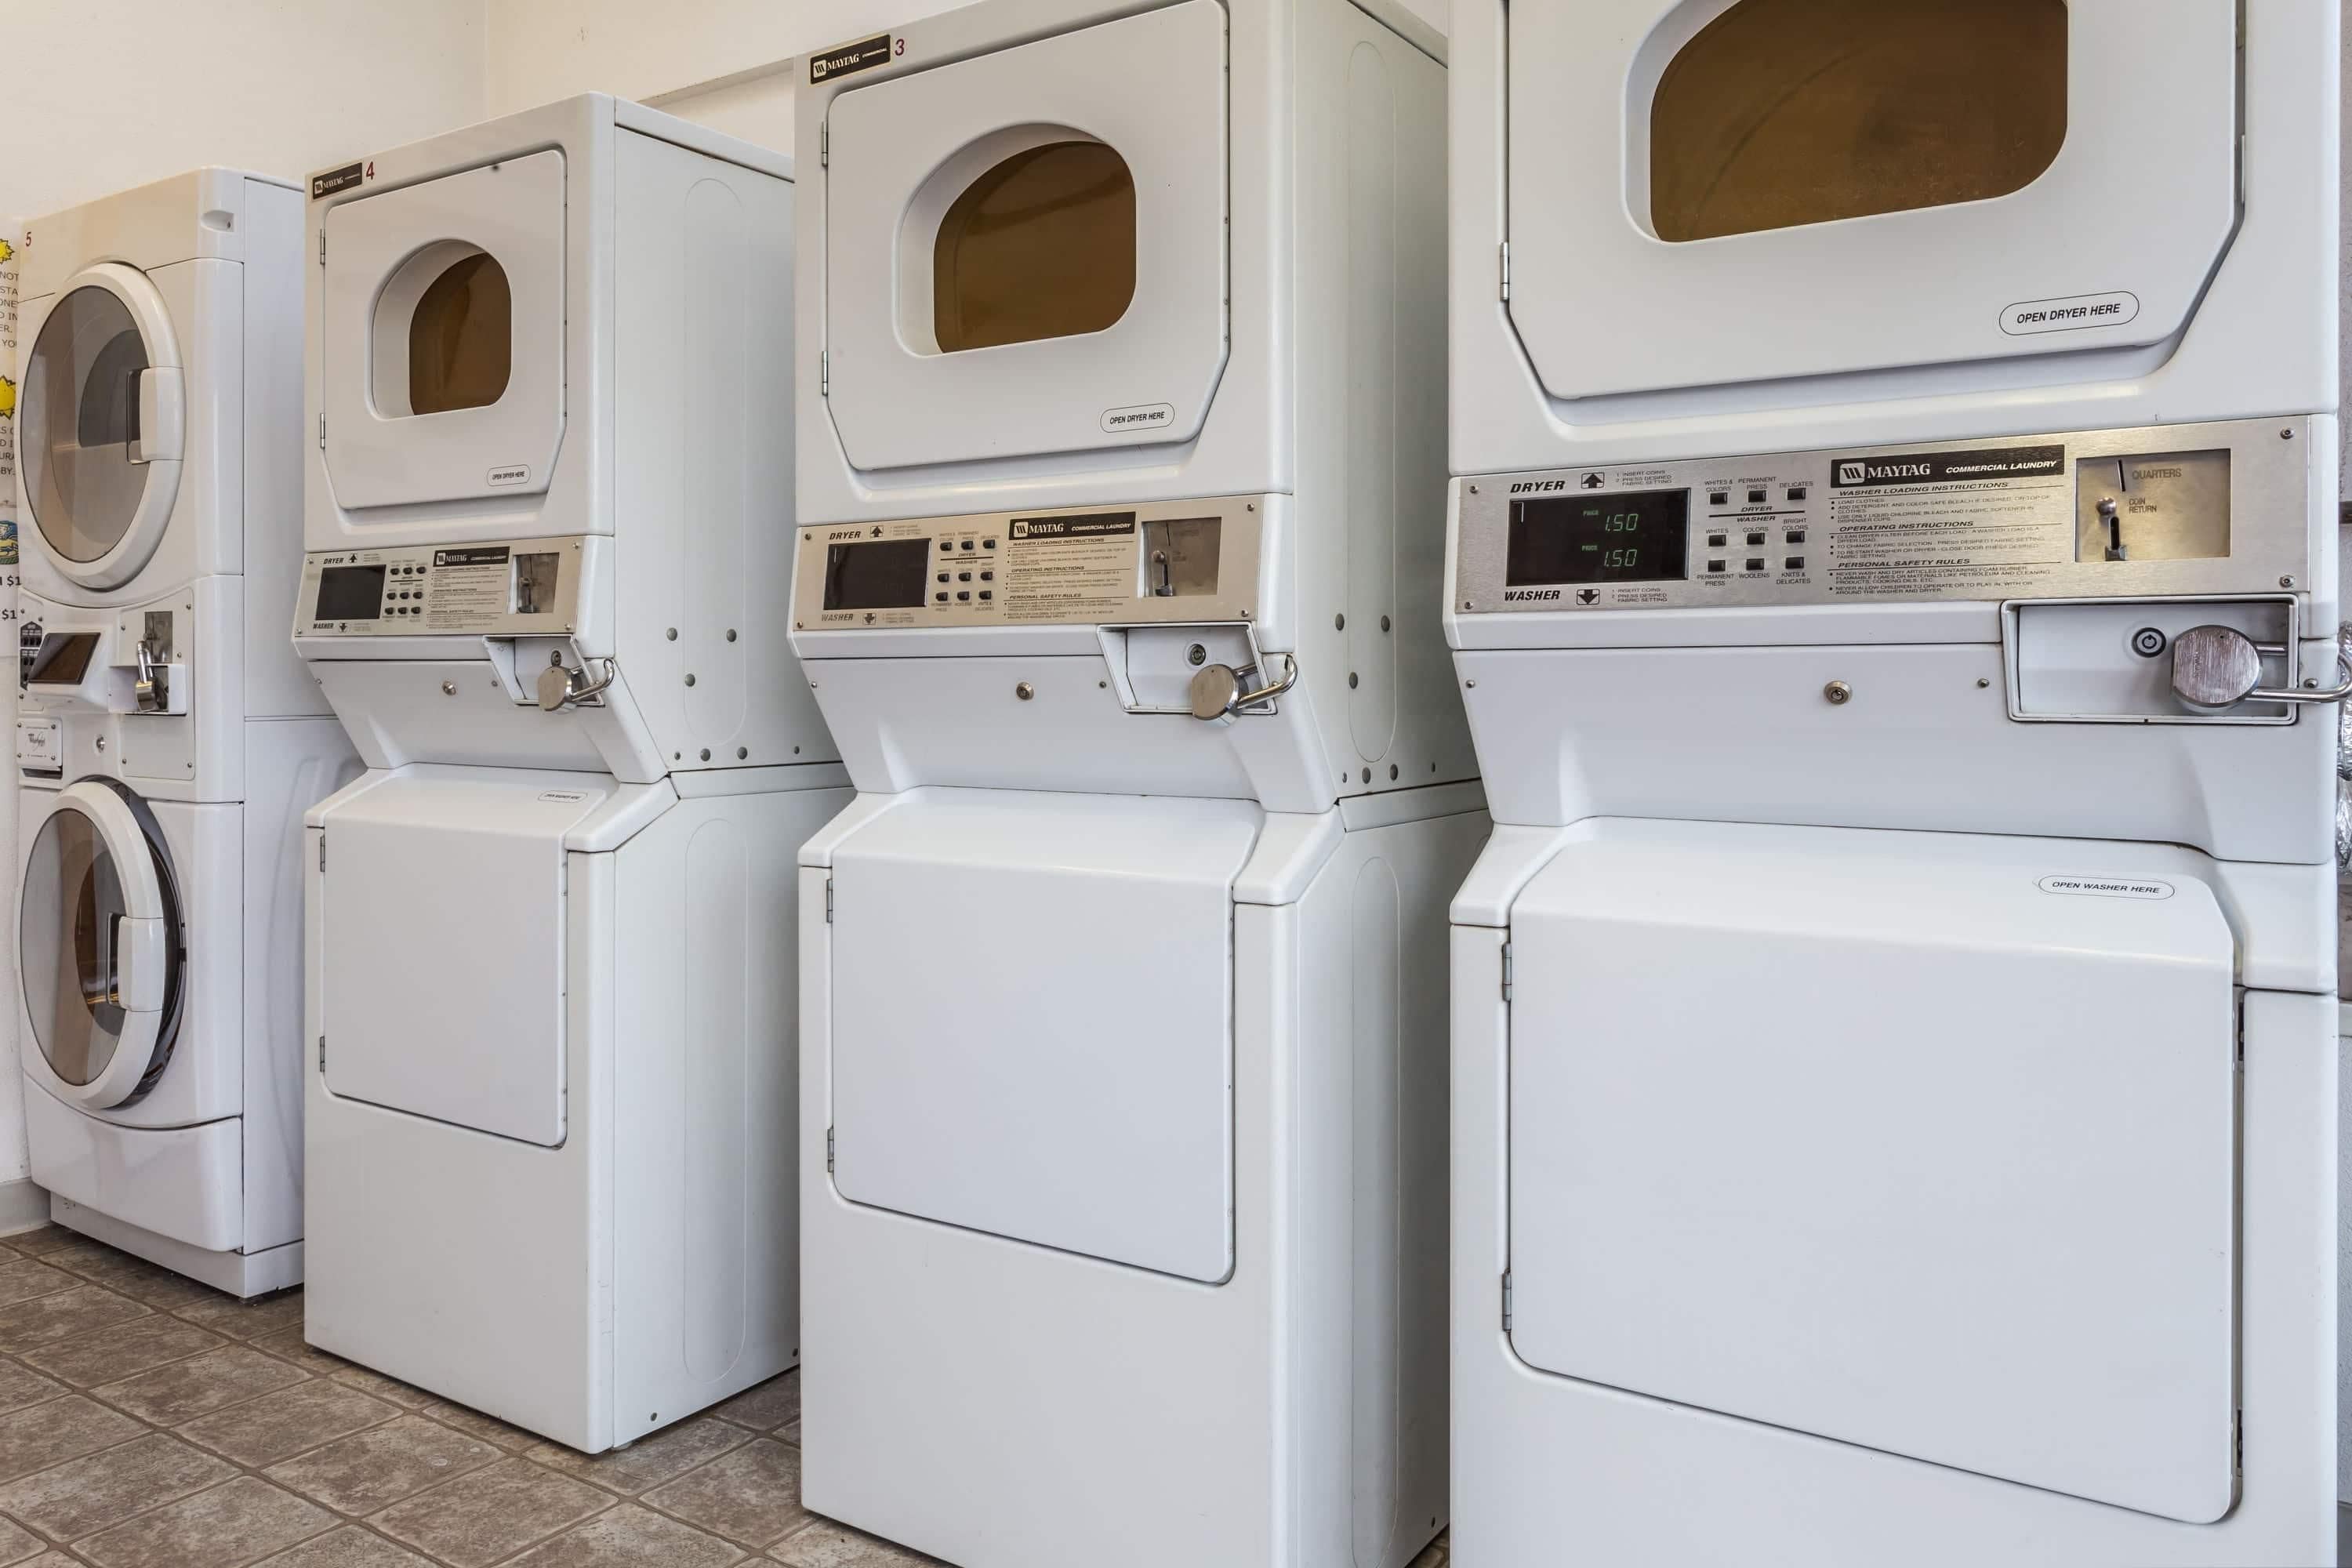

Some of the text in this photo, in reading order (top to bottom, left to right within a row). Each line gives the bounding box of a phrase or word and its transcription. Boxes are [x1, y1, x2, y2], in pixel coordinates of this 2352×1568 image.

[895, 38, 906, 56] 3
[827, 53, 860, 71] MAYTAG
[365, 162, 375, 180] 4
[26, 231, 32, 247] 5
[2016, 303, 2121, 324] OPEN DRYER HERE
[2, 339, 17, 348] YO
[1109, 411, 1166, 425] OPEN DRYER HERE
[1867, 460, 2057, 478] MAYTAG COMMERCIAL LAUNDRY
[2132, 468, 2183, 480] QUARTERS
[1510, 480, 1566, 493] DRYER
[1932, 482, 2009, 492] INSTRUCTIONS
[2129, 497, 2146, 506] COIN
[2129, 505, 2158, 514] RETURN
[1029, 523, 1064, 534] MAYTAG
[1605, 514, 1639, 532] 1.50
[1839, 521, 1974, 532] OPERATING INSTRUCTIONS
[829, 531, 862, 540] DRYER
[1604, 549, 1638, 567] 1.50
[1504, 590, 1561, 601] WASHER
[821, 613, 854, 622] WASHER
[2084, 883, 2128, 892] WASHER
